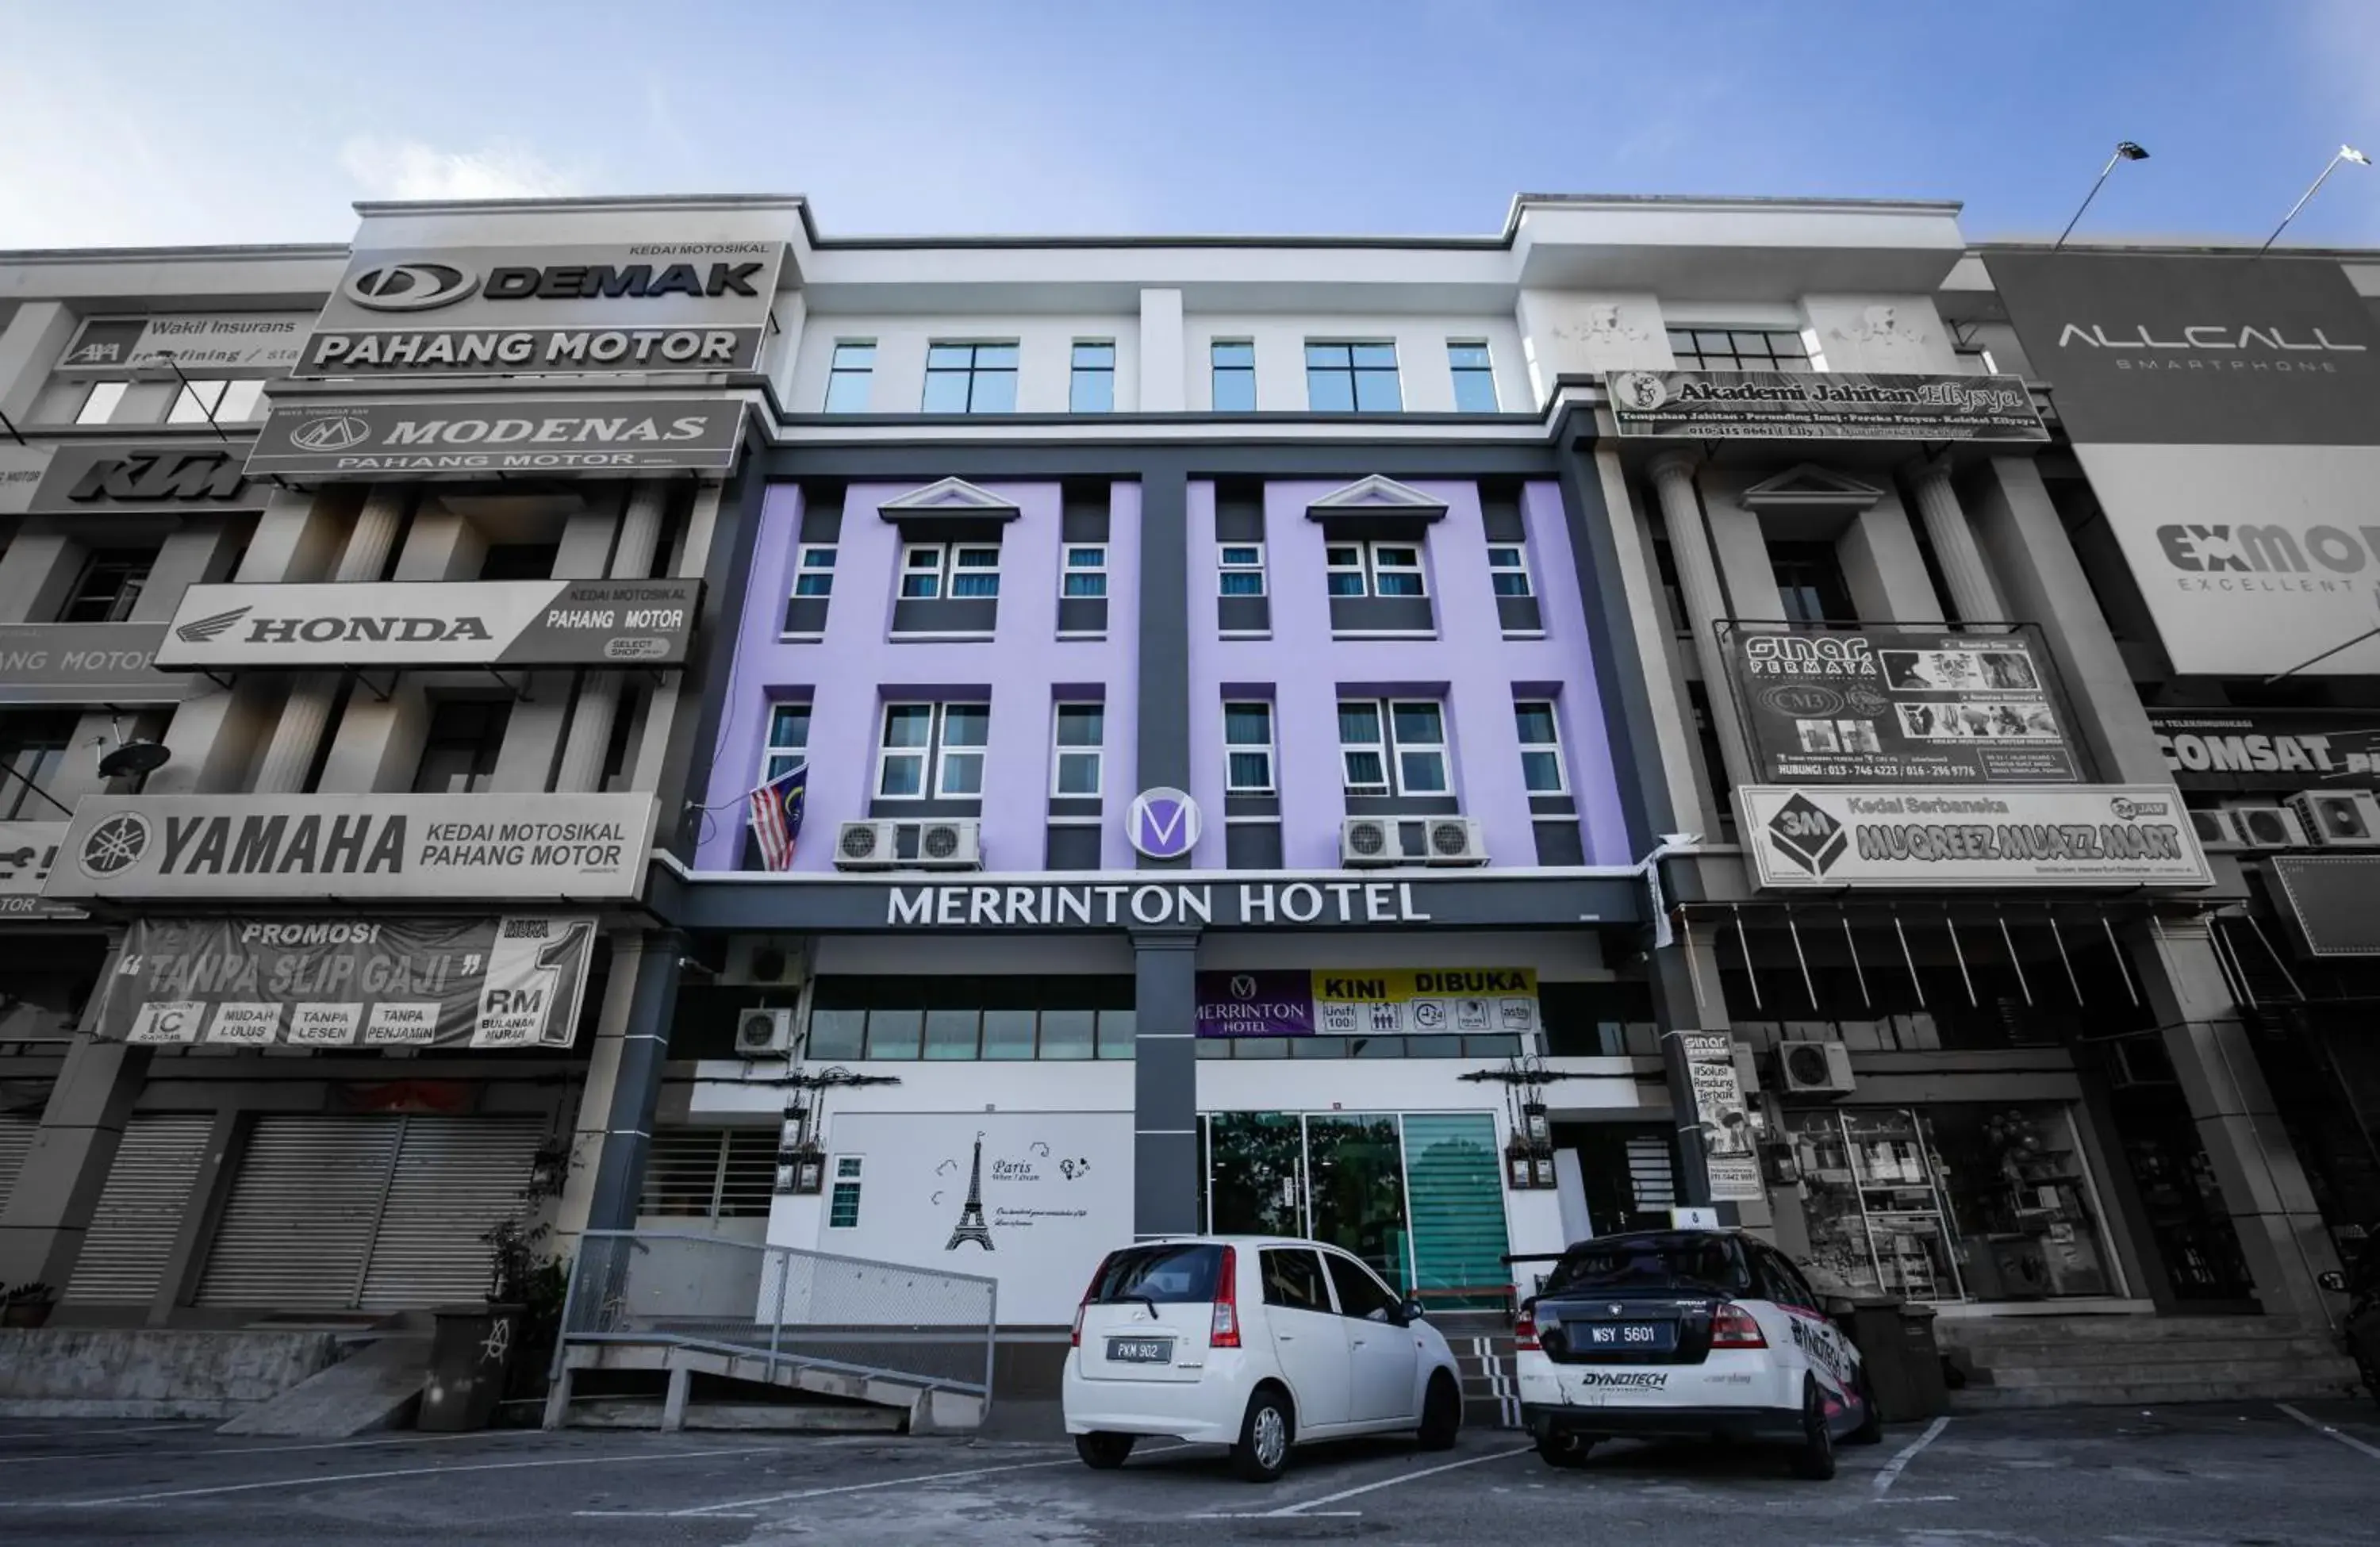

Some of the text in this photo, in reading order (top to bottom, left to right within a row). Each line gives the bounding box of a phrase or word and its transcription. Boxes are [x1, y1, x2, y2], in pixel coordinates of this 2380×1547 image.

[629, 244, 770, 255] KEDAI MOTOSIKAL
[482, 262, 765, 299] DEMAK
[151, 320, 297, 336] Wakil Insurans
[2058, 323, 2367, 351] ALLCALL
[313, 330, 739, 367] PAHANG MOTOR
[2115, 357, 2338, 373] SMARTPHONE
[1678, 382, 1809, 402] Akademi
[1810, 383, 1921, 404] Jahitan
[1622, 412, 1687, 421] Tempahan
[1689, 413, 1735, 421] Jahitan
[382, 416, 708, 446] MODENAS
[337, 457, 489, 470] PAHANG
[502, 453, 635, 467] MOTOR
[67, 450, 245, 501] KTM
[2176, 578, 2354, 593] EXCELLENT
[570, 588, 686, 601] KEDAI MOTOSIKAL
[545, 608, 684, 628] PAHANG MOTOR
[244, 616, 493, 643] HONDA
[610, 647, 640, 656] SHOP
[1749, 661, 1877, 674] PERMATA
[1846, 797, 2010, 814] Kedai Serbaneka
[2137, 804, 2164, 814] JAM
[1780, 810, 1833, 836] 3M
[426, 823, 625, 841] KEDAI MOTOSIKAL
[159, 814, 409, 874] YAMAHA
[1856, 823, 2182, 862] MUQREEZ MUAZZ MART
[420, 845, 621, 866] PAHANG MOTOR
[887, 882, 1431, 924] MERRINTON HOTEL
[240, 923, 382, 945] PROMOSI
[268, 954, 355, 993] SLIP
[1414, 971, 1529, 993] DIBUKA
[1324, 977, 1387, 1000] KINI
[486, 989, 543, 1014] RM
[224, 1009, 274, 1022] MUDAH
[302, 1012, 349, 1023] TANPA
[382, 1010, 424, 1022] TANPA
[220, 1025, 267, 1038] LULUS
[298, 1027, 348, 1039] LESEN
[367, 1027, 433, 1038] PENJAMIN
[1223, 1020, 1269, 1033] HOTEL
[992, 1158, 1033, 1173] Paris
[1591, 1326, 1655, 1343] WSY 5601
